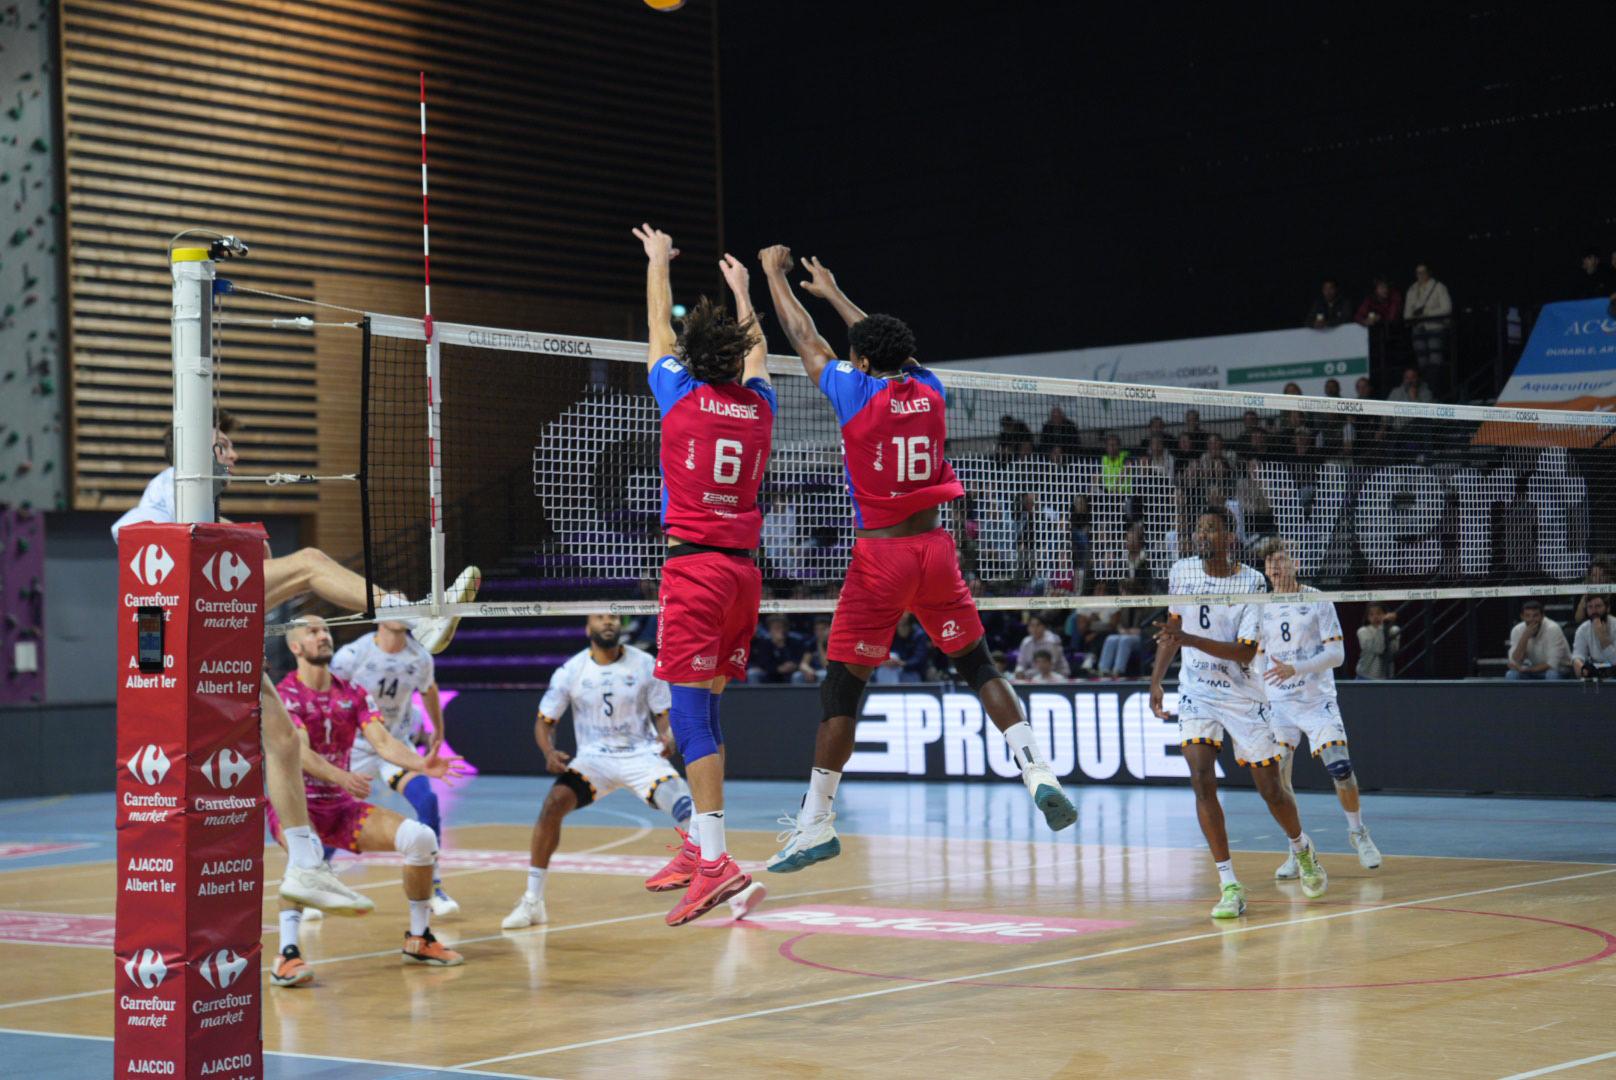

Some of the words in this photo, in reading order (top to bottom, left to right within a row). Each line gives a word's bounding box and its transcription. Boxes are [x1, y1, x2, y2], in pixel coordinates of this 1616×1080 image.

[467, 329, 532, 350] CULLETTIVITÀ
[543, 338, 593, 356] CORSICA
[1012, 378, 1038, 391] CORSE
[1124, 387, 1156, 400] CORSICA
[700, 396, 760, 419] LACASSIE
[1337, 401, 1363, 413] CORSICA
[1516, 411, 1539, 421] CORSICA
[713, 438, 743, 485] 6
[891, 436, 932, 482] 16
[1253, 443, 1592, 580] vert
[124, 593, 179, 607] Carrefour
[195, 598, 257, 613] Carrefour
[480, 604, 508, 616] Gamm
[512, 605, 530, 616] vert
[1200, 604, 1210, 629] 6
[203, 616, 248, 630] market
[1280, 621, 1291, 642] 8
[199, 660, 252, 674] AJACCIO
[126, 676, 158, 689] Albert
[160, 676, 177, 689] 1er
[196, 681, 233, 694] Albert
[236, 681, 254, 694] 1er
[378, 677, 399, 699] 14
[602, 692, 614, 717] 5
[324, 718, 332, 744] 1
[124, 792, 177, 807] Carrefour
[195, 795, 256, 812] Carrefour
[128, 809, 168, 823] market
[203, 811, 248, 826] market
[128, 858, 174, 872] AJACCIO
[201, 858, 253, 876] AJACCIO
[125, 878, 158, 892] Albert
[160, 879, 176, 893] 1er
[197, 882, 235, 897] Albert
[238, 880, 255, 893] 1er
[120, 996, 176, 1012] Carrefour
[192, 993, 253, 1015] Carrefour
[127, 1013, 168, 1028] market
[200, 1009, 244, 1029] market
[127, 1059, 175, 1074] AJACCIO
[200, 1053, 252, 1076] AJACCIO
